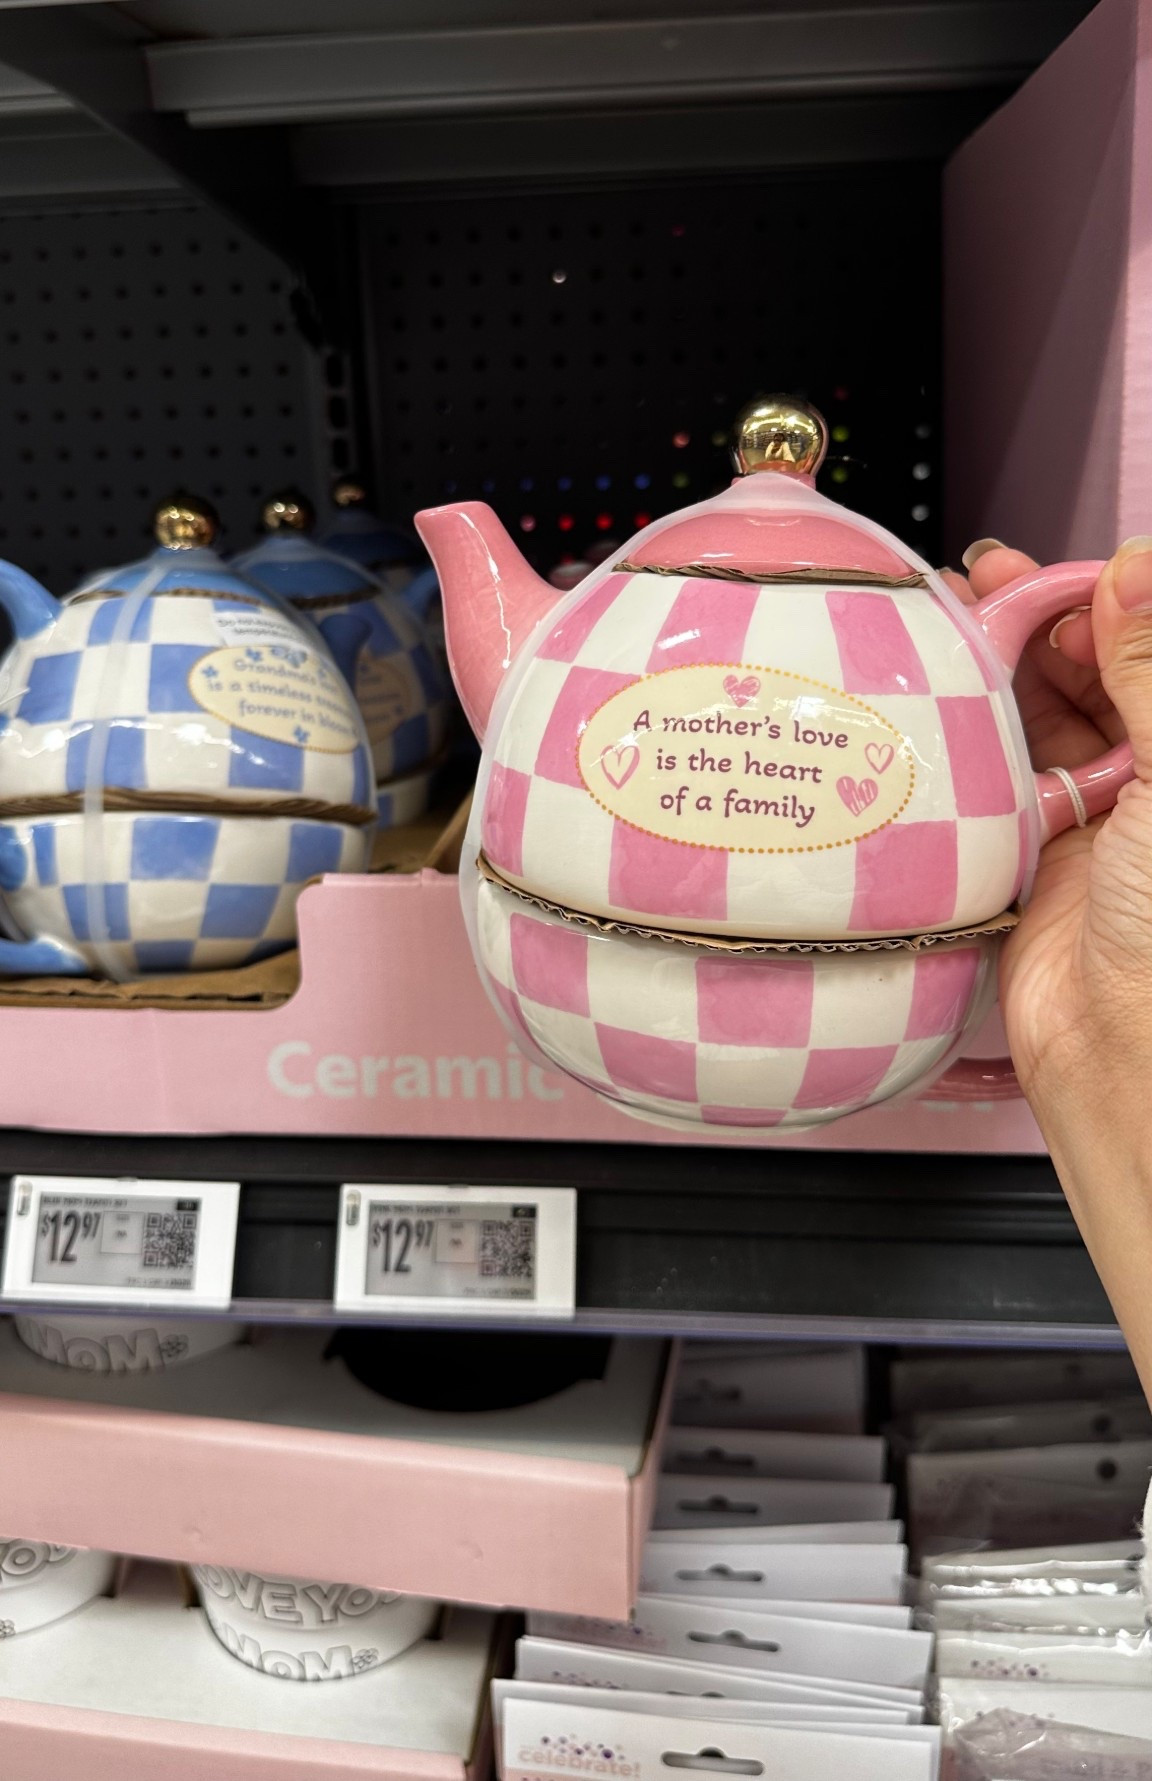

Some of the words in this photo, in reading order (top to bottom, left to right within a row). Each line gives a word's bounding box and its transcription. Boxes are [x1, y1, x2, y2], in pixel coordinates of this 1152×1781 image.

[238, 699, 296, 717] forever
[633, 710, 651, 732] A
[662, 710, 782, 740] mother's
[793, 720, 849, 749] love
[656, 748, 677, 771] is
[688, 747, 733, 773] the
[744, 750, 823, 783] heart
[659, 786, 690, 816] of
[695, 793, 713, 812] a
[723, 788, 816, 829] family
[266, 1040, 565, 1101] Ceramic
